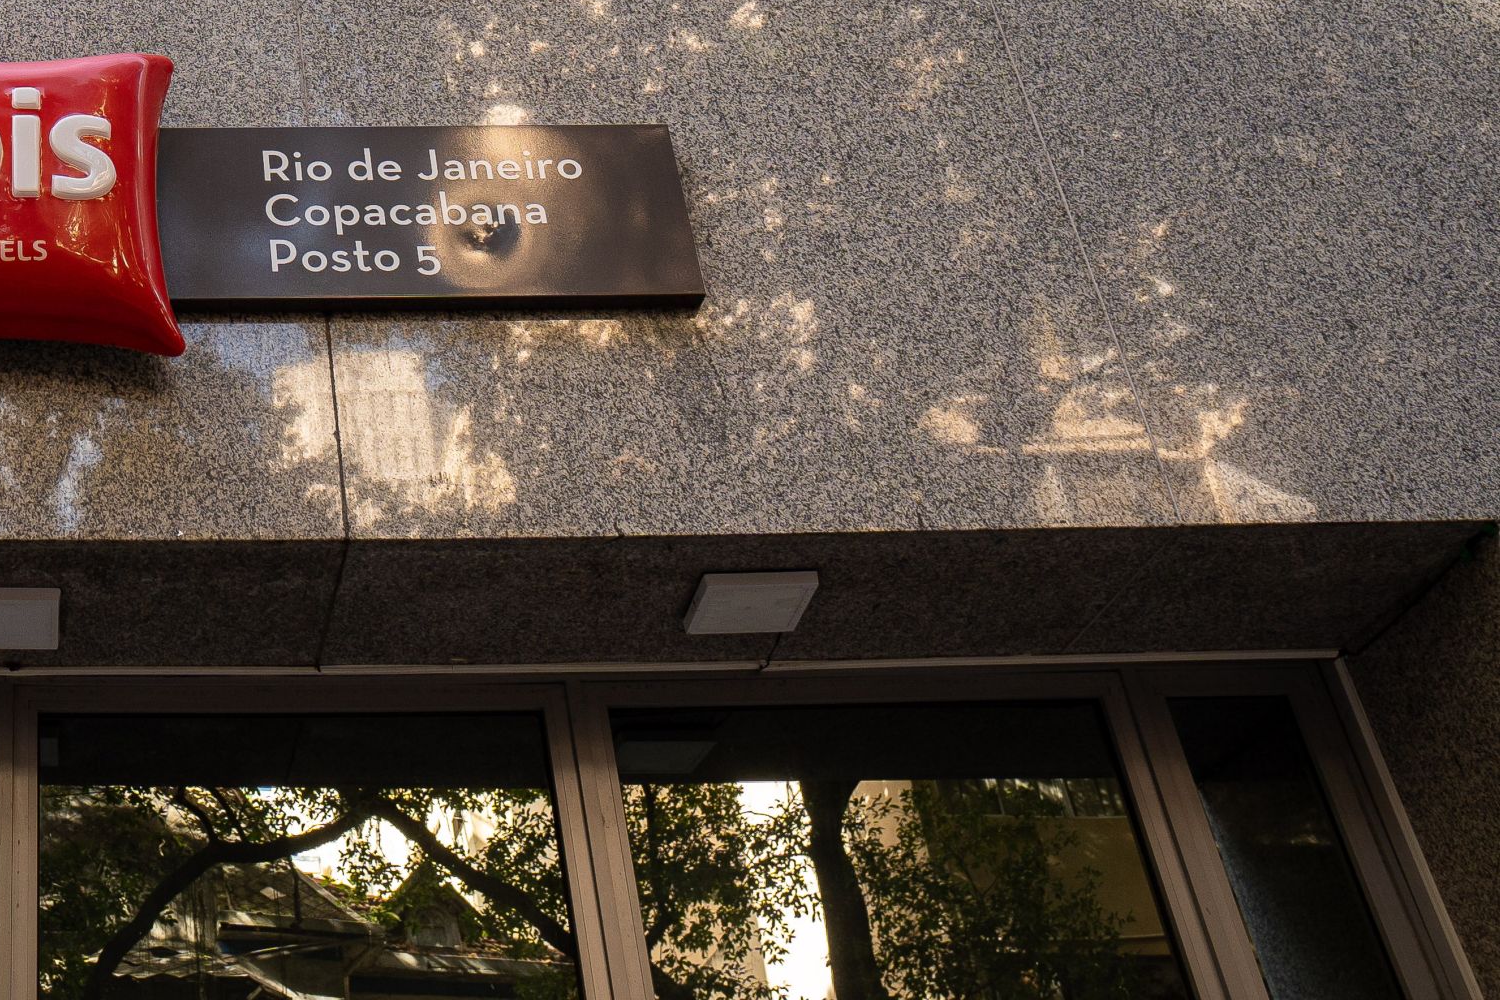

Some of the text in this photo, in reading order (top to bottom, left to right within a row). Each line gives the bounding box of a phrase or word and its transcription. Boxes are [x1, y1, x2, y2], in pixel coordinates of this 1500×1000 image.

[262, 148, 583, 182] Rio de Janeiro
[265, 191, 548, 235] Copacabana
[269, 239, 442, 276] Posto 5
